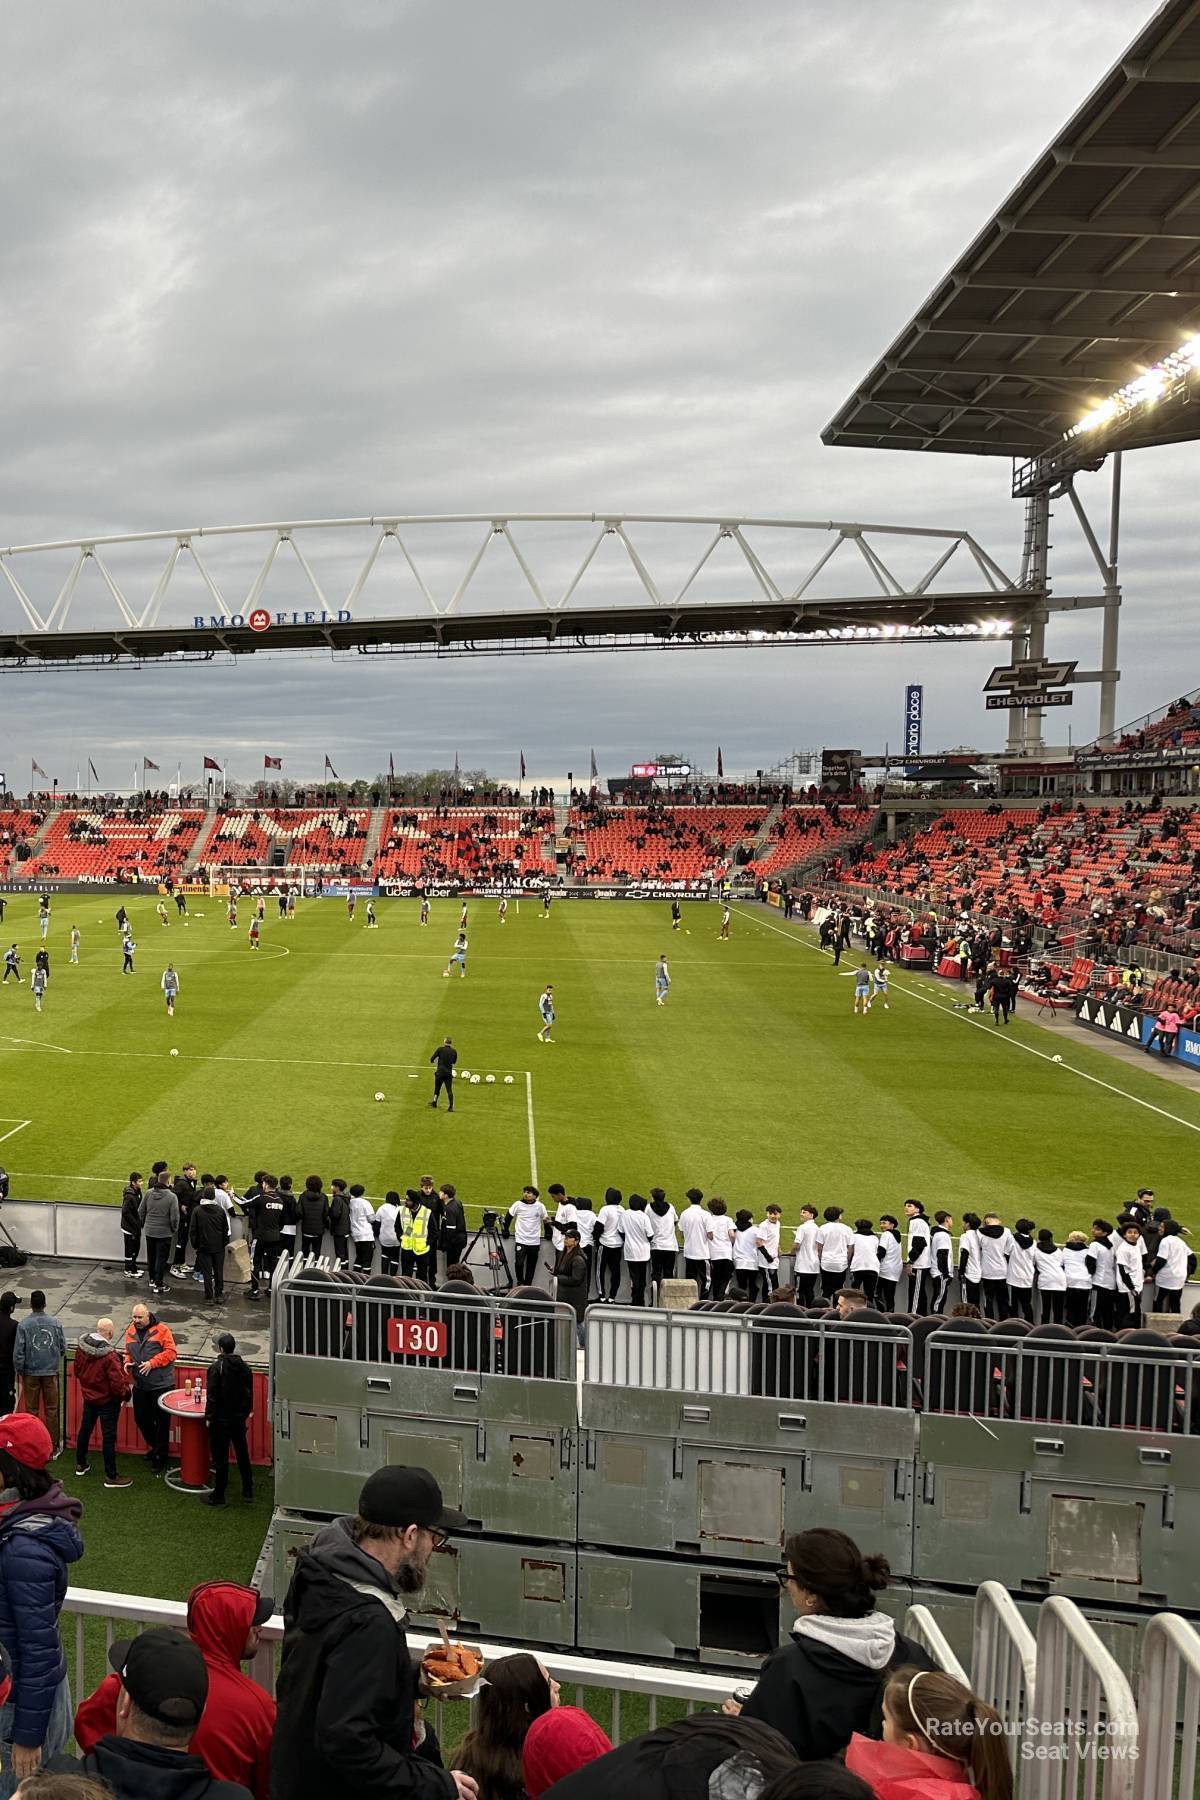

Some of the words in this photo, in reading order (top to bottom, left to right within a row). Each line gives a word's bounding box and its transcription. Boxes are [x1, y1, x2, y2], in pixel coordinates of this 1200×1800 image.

[193, 615, 244, 628] BMO
[276, 610, 353, 625] FIELD
[906, 691, 922, 721] place
[988, 693, 1068, 706] CHEVROLET
[424, 887, 451, 897] Uber
[652, 891, 708, 899] CHEVROLET
[395, 1323, 438, 1352] 130
